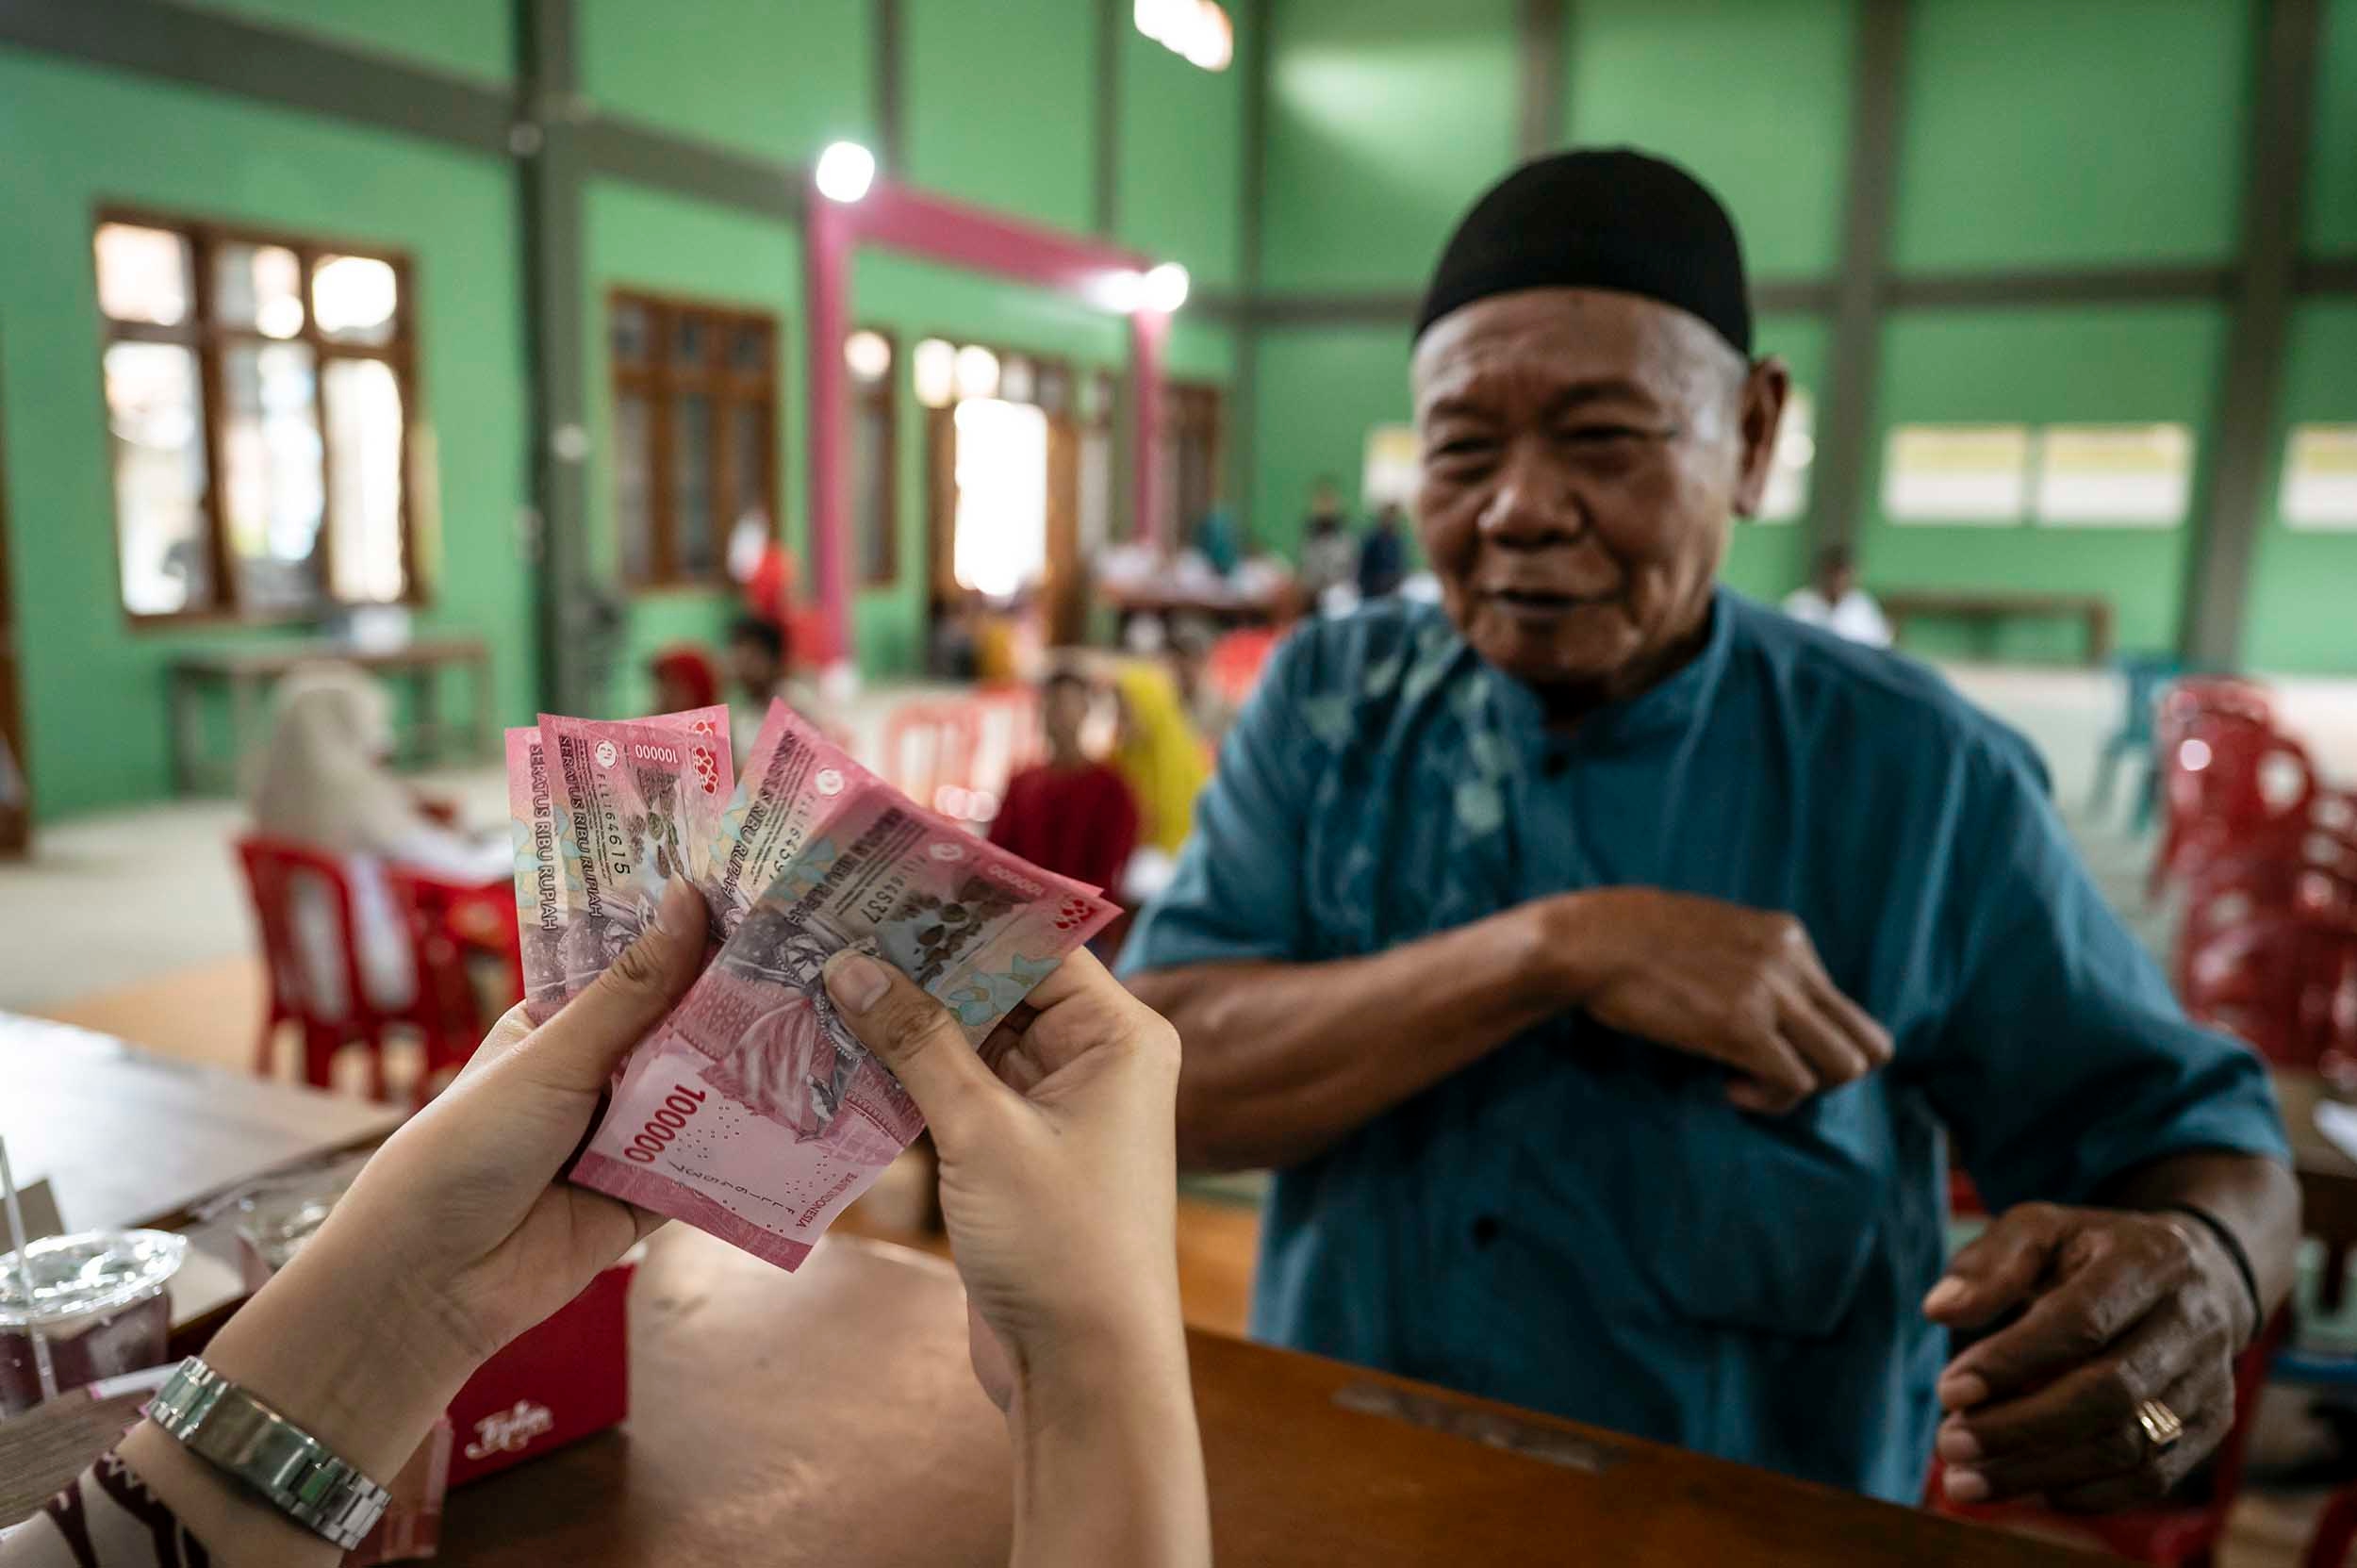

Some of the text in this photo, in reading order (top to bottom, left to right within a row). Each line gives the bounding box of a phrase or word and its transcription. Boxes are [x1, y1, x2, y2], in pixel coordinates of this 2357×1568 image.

[558, 735, 583, 811] SERATUS
[635, 744, 678, 764] 100000
[530, 743, 558, 931] SERATUS RIBU RUPIAH
[573, 812, 590, 853] RIBU
[581, 857, 603, 917] RUPIAH
[624, 1084, 706, 1163] 100000
